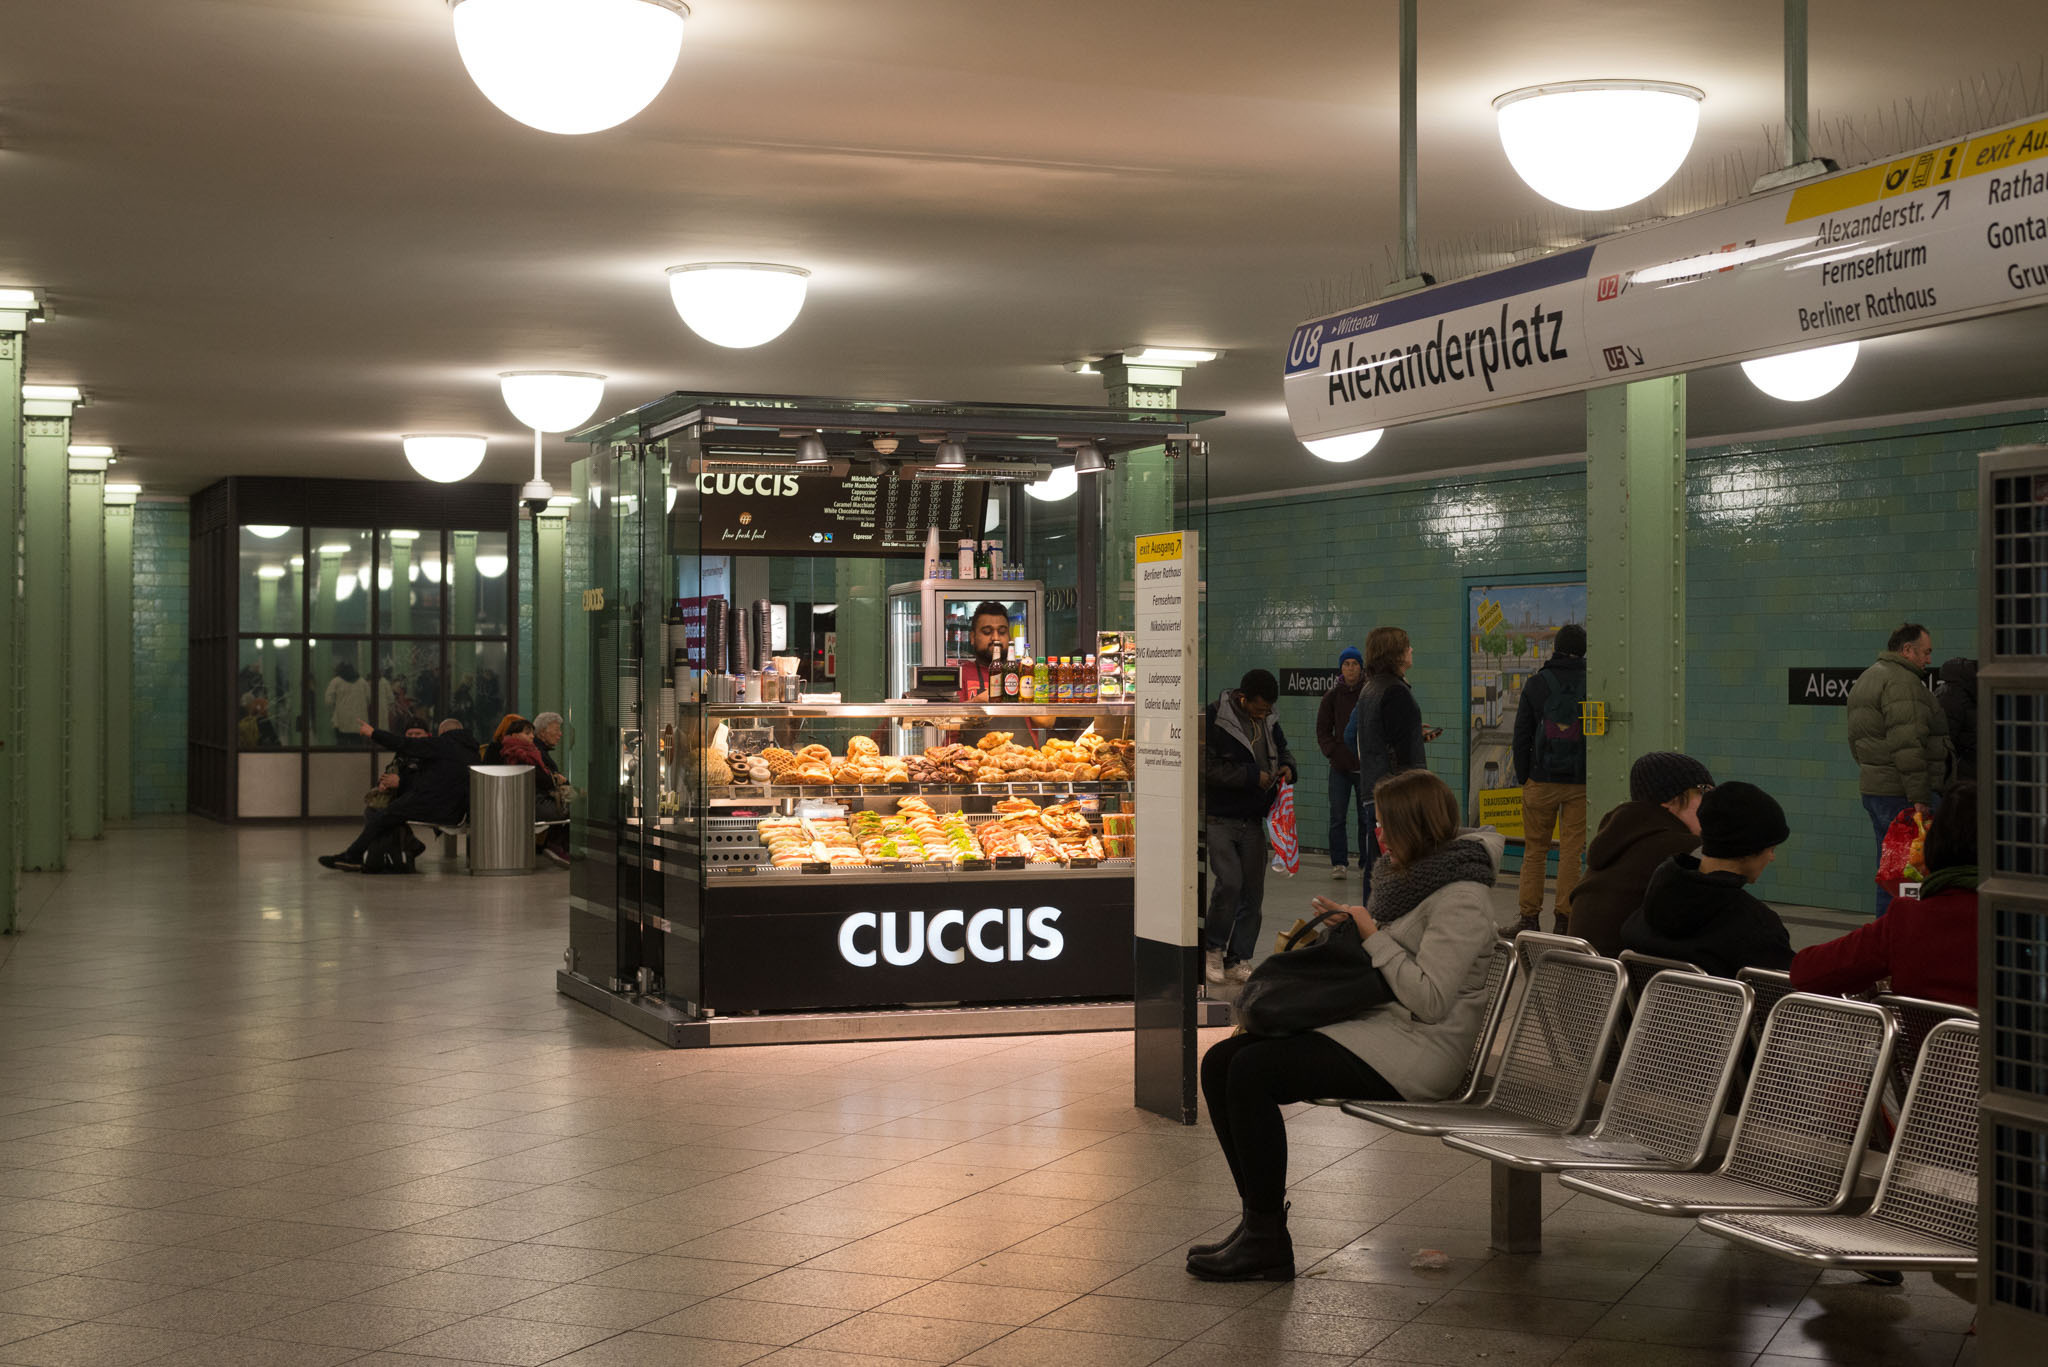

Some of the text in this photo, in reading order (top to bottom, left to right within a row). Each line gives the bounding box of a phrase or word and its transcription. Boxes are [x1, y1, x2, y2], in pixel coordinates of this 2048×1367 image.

[1976, 135, 2016, 166] exit
[1989, 168, 2048, 205] Ratha
[1815, 202, 1925, 246] Alexanderstr.
[1822, 245, 1926, 286] Fernsehturm
[2008, 262, 2048, 290] Gru
[1600, 278, 1617, 298] U2
[1799, 286, 1937, 331] Berliner Rathaus
[1337, 312, 1379, 335] Wittenau
[1290, 324, 1323, 367] U8
[1329, 303, 1568, 405] Alexanderplatz
[1607, 350, 1625, 369] U5
[696, 473, 799, 496] CUCCIS
[735, 529, 750, 540] fresh
[751, 529, 766, 540] food
[1140, 541, 1175, 556] exit Ausgang
[1144, 566, 1181, 580] Berliner Rathaus
[1152, 594, 1181, 606] Fernsehturm
[1150, 619, 1181, 631] Nikolaiviertel
[1146, 647, 1182, 658] Kundenzentrum
[1148, 673, 1181, 687] Ladenpassage
[1145, 698, 1181, 710] Galeria Kaufhof
[1170, 723, 1181, 739] bcc
[838, 906, 1064, 967] CUCCIS
